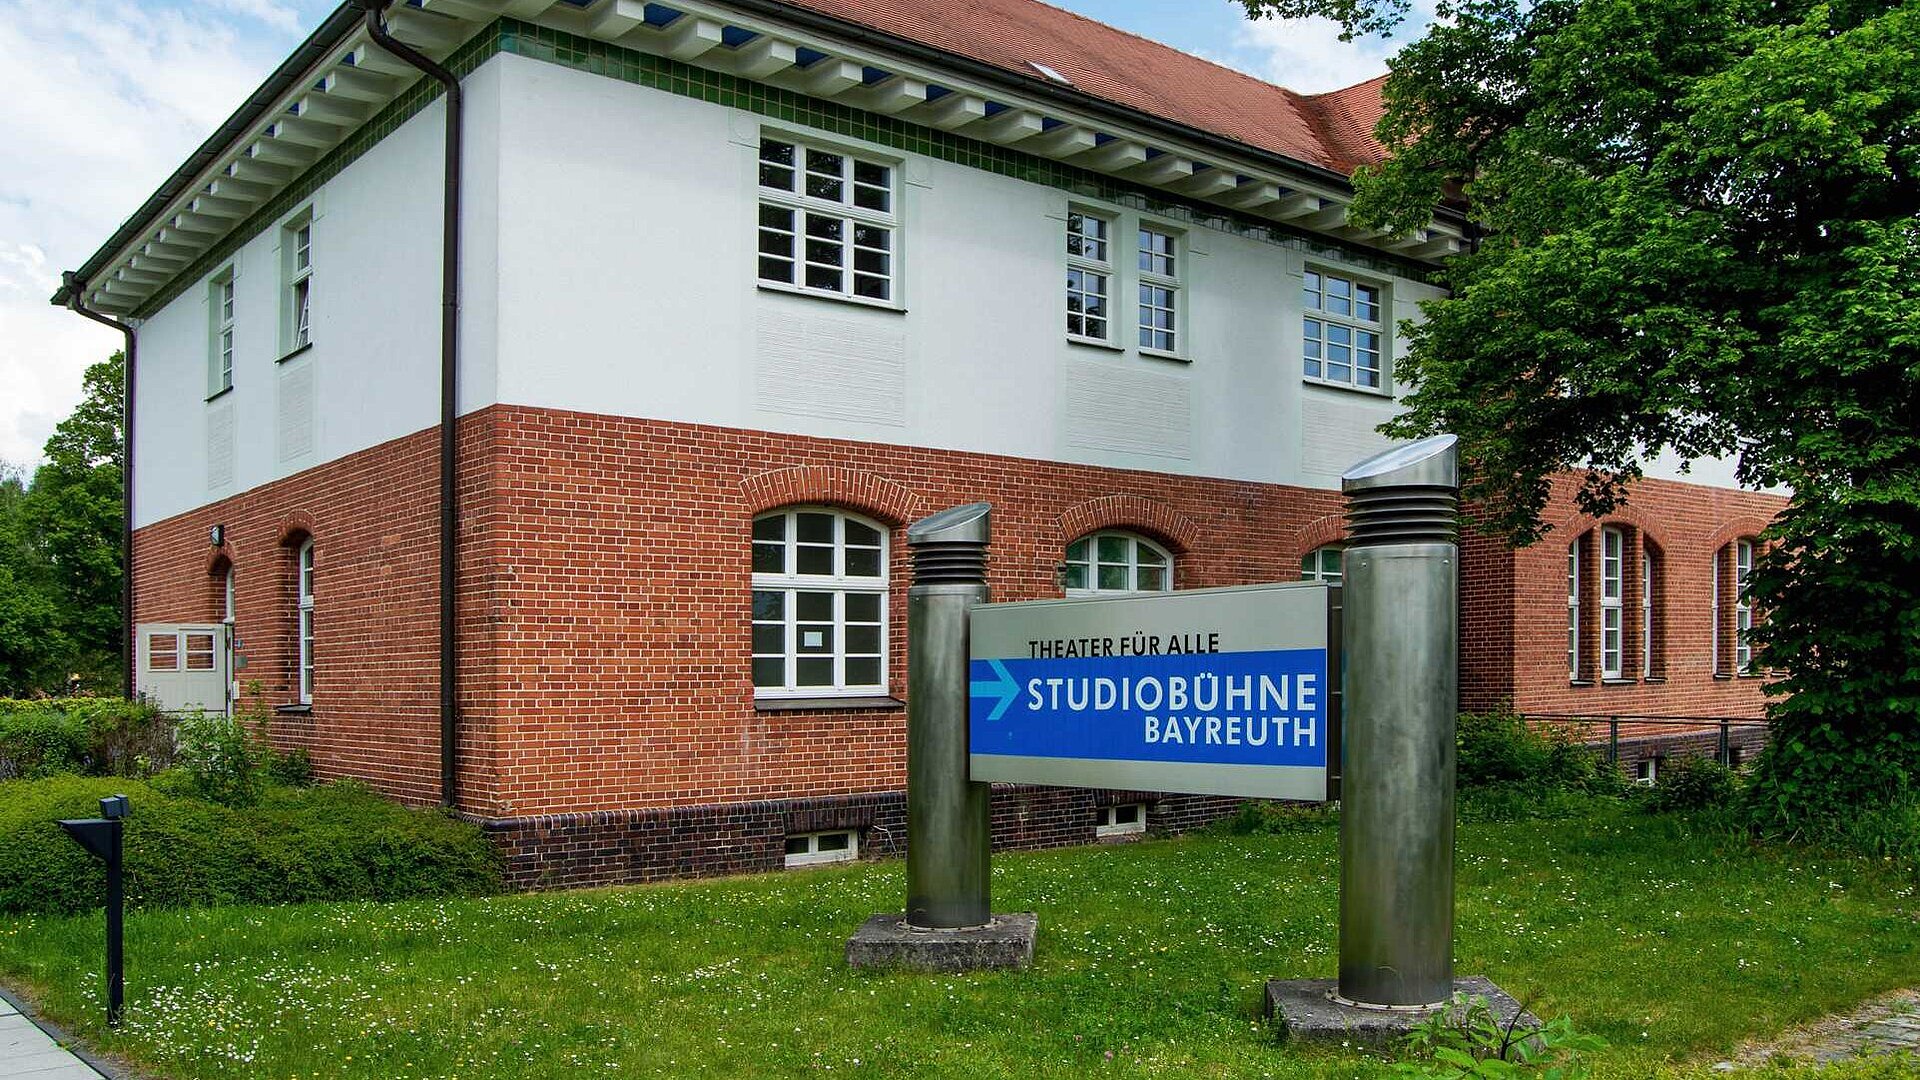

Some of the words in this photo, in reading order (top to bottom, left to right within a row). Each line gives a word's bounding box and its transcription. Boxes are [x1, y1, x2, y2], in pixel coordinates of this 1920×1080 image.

[1029, 638, 1113, 659] THEATER
[1120, 631, 1160, 656] FÜR
[1167, 633, 1219, 655] ALLE
[1028, 673, 1317, 711] STUDIOBÜHNE
[1145, 716, 1316, 746] BAYREUTH
